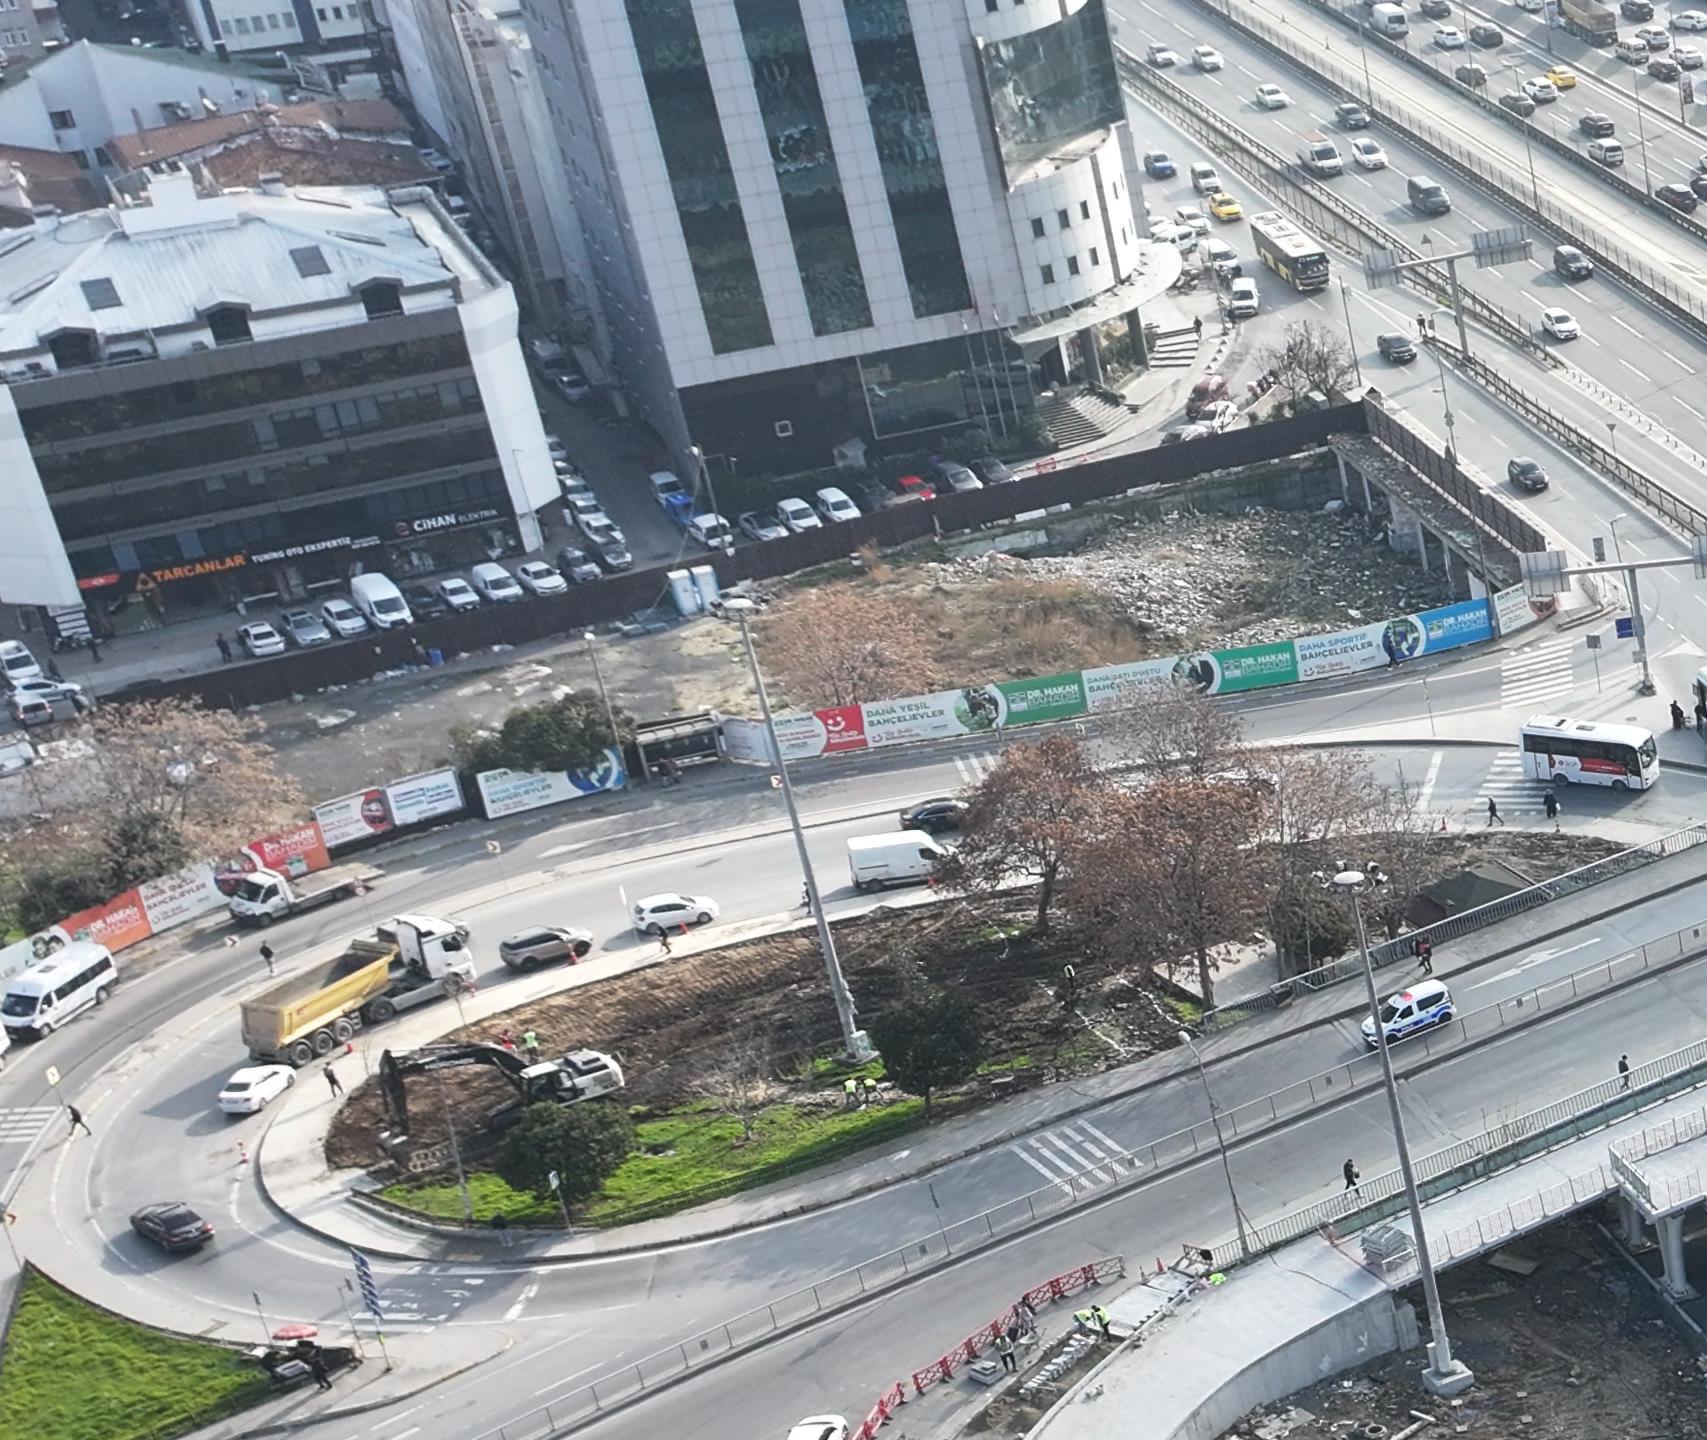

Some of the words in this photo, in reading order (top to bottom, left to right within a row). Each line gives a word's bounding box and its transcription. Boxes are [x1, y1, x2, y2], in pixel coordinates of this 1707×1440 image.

[152, 553, 246, 582] TARCANLAR
[1258, 651, 1291, 664] HAKAN
[1044, 683, 1079, 697] HAKAN
[867, 706, 896, 718] DAHA
